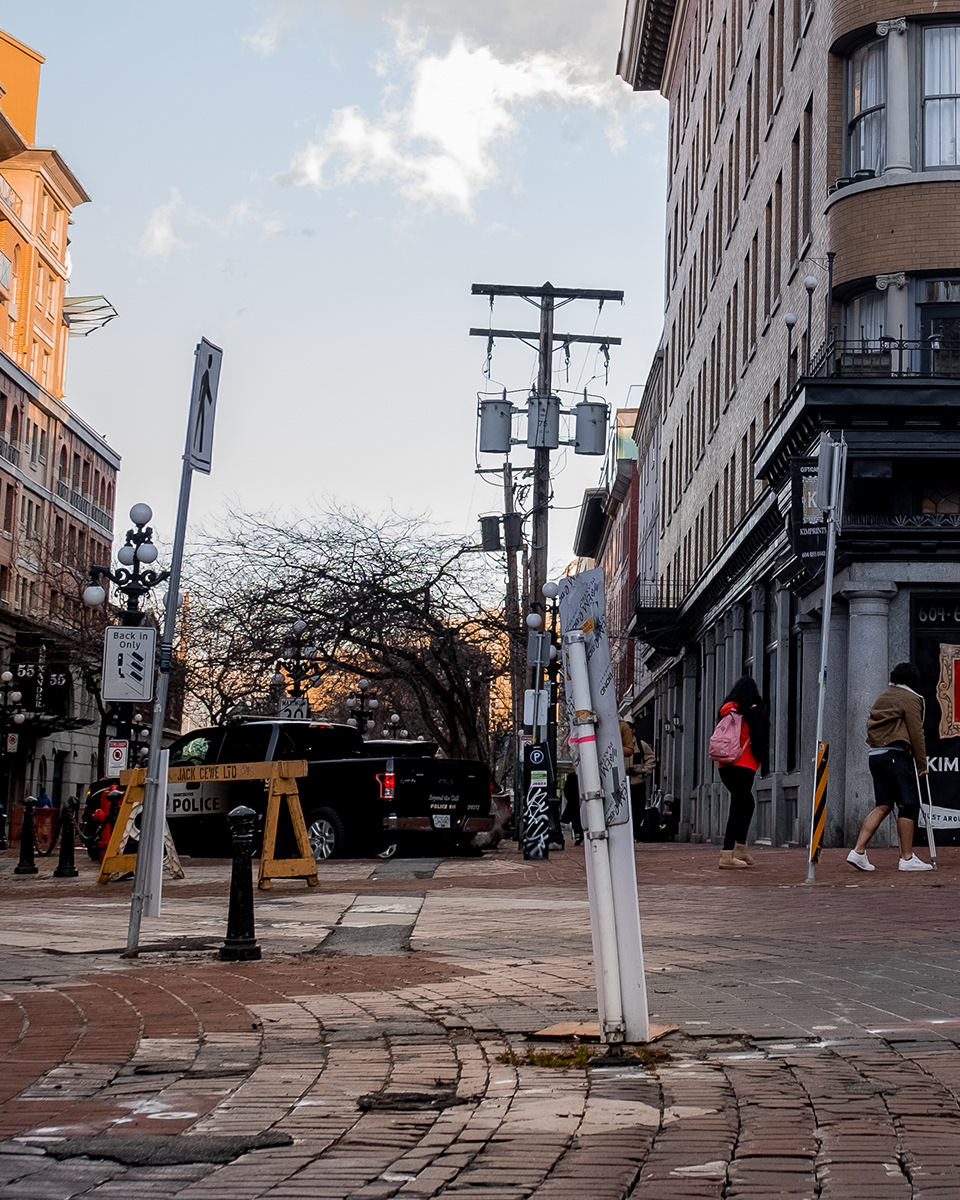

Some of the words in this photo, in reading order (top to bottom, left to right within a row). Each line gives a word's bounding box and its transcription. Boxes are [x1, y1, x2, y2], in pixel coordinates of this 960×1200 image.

[113, 631, 135, 640] Back
[139, 631, 148, 640] in
[119, 640, 141, 650] Only
[17, 664, 35, 677] 55
[49, 673, 66, 686] 55
[533, 752, 541, 762] P
[177, 767, 196, 780] JACK
[199, 765, 219, 779] CEWE
[172, 797, 220, 812] POLICE
